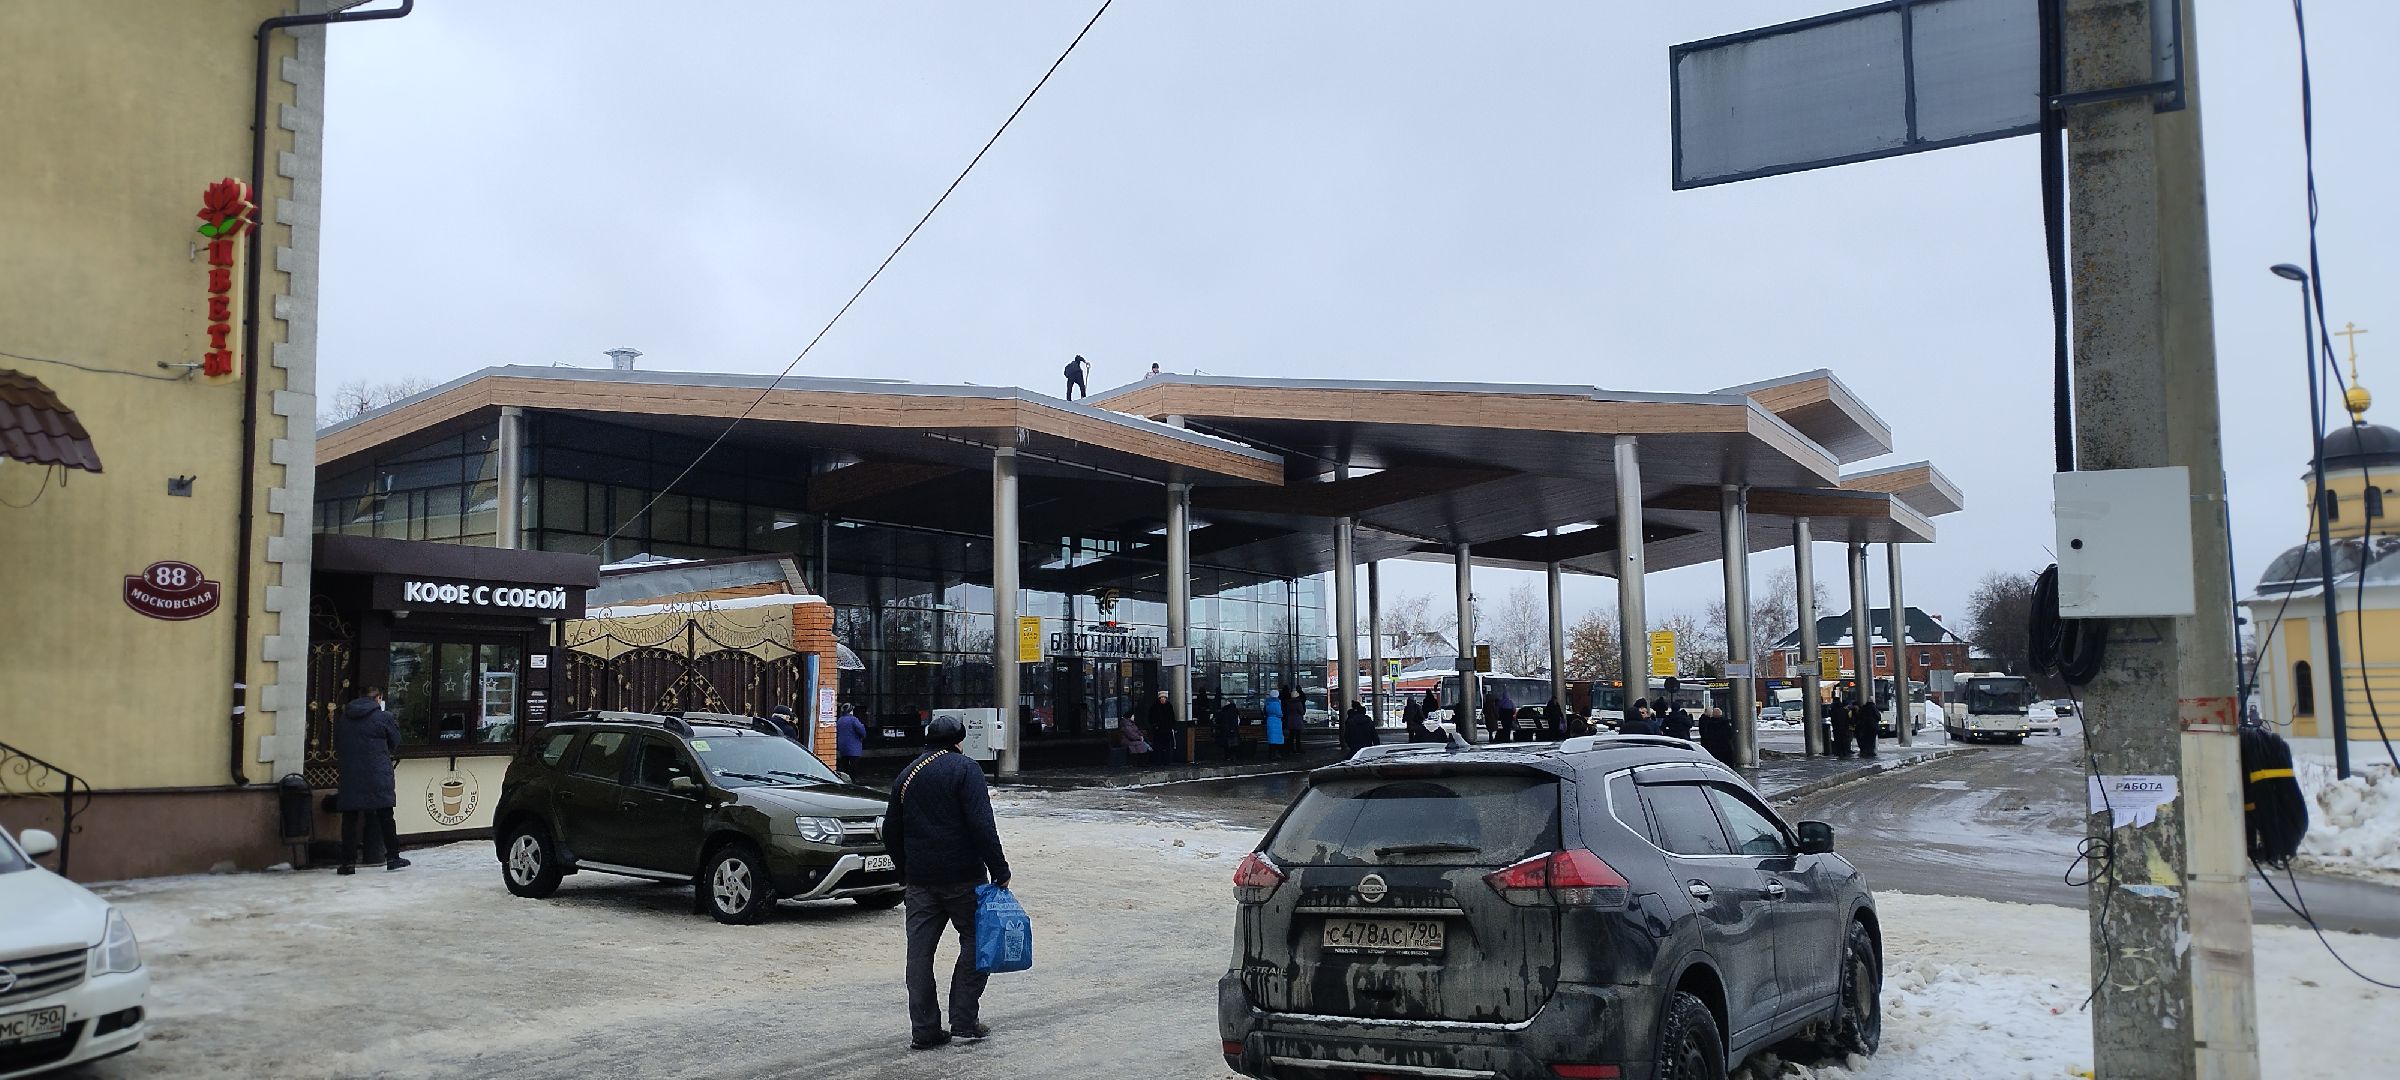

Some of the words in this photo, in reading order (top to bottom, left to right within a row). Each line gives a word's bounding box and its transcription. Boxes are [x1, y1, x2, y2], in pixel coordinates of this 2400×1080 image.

[204, 239, 234, 377] ЦВЕТЫ
[156, 567, 186, 586] 88
[131, 587, 212, 609] МОСКОВСКАЯ
[404, 581, 470, 604] КОФЕ
[472, 585, 490, 605] С
[492, 587, 567, 610] СОБОЙ
[2115, 782, 2163, 790] РАБОТА
[427, 792, 442, 820] ВРЕМЯ
[442, 815, 464, 824] ПИТЬ
[464, 791, 477, 815] КОФЕ
[1329, 922, 1403, 946] С478АС
[1408, 921, 1438, 940] 790
[30, 1010, 58, 1029] 750
